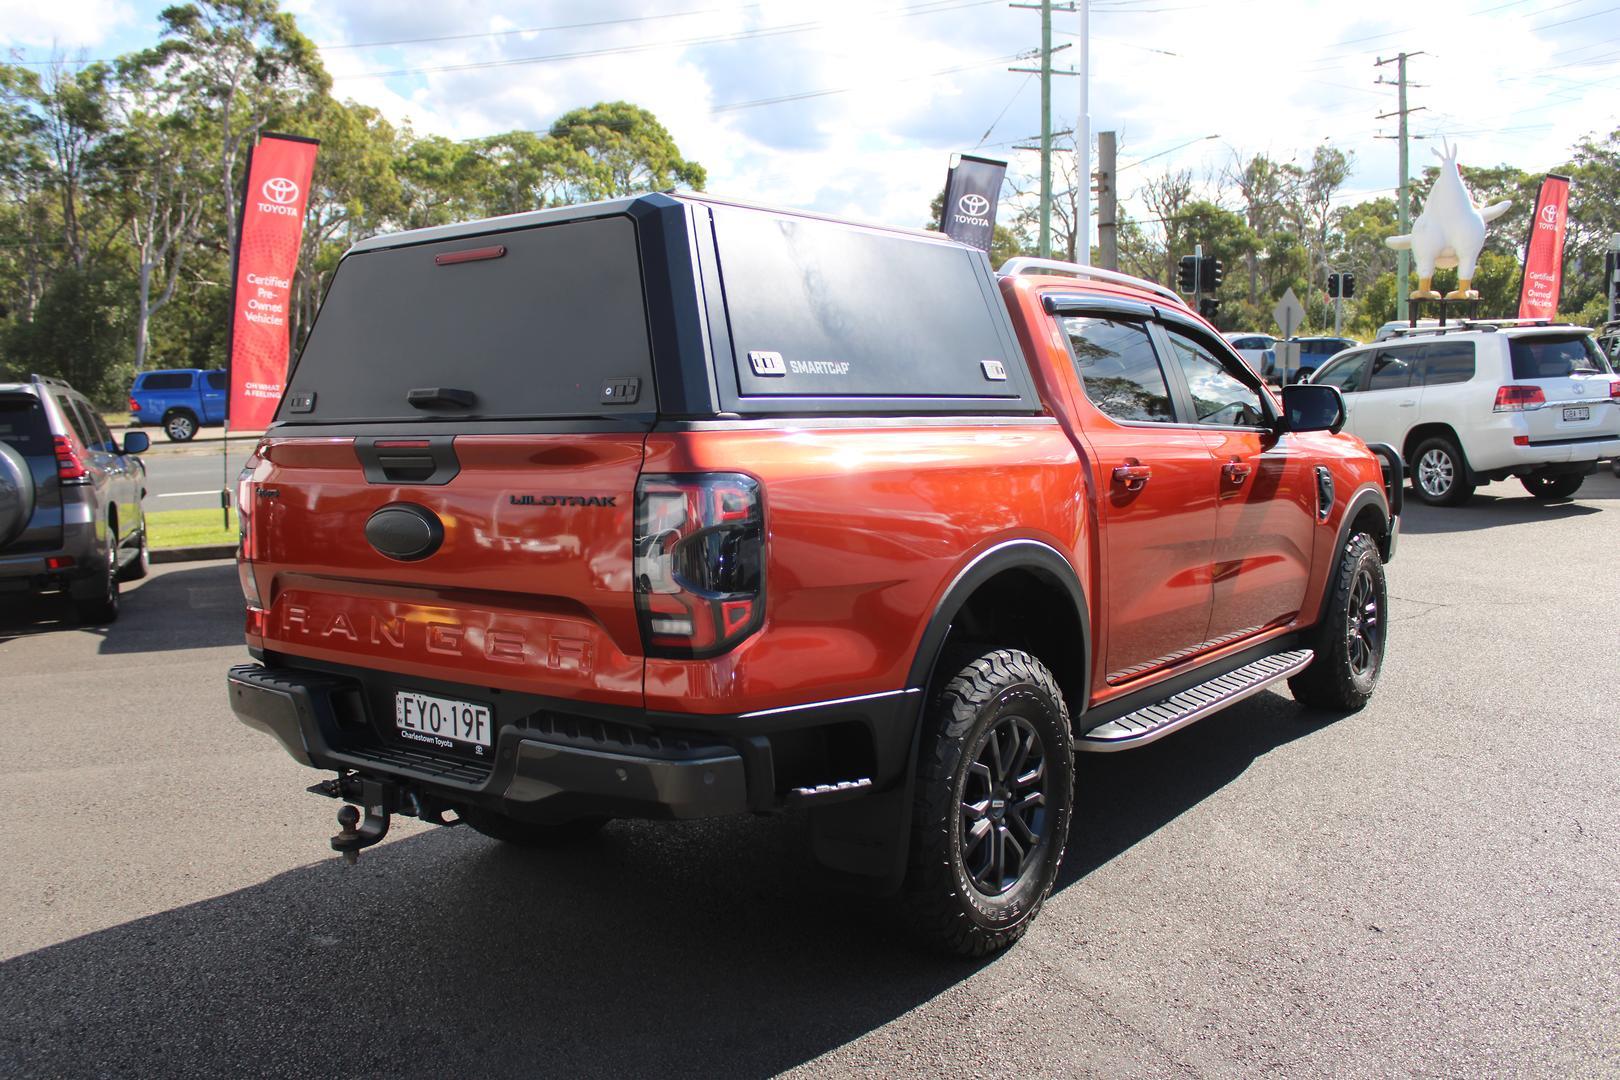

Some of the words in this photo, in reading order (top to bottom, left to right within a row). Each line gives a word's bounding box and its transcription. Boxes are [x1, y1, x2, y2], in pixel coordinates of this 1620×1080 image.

[257, 202, 298, 217] TOYOTA
[954, 214, 989, 227] TOYOTA
[247, 273, 289, 289] Certified
[257, 288, 278, 299] Pre-
[248, 300, 283, 313] Owned
[789, 360, 849, 375] SMARTCAP
[510, 495, 616, 507] WILDTRAK
[282, 605, 593, 674] RANGER
[401, 730, 434, 744] Charlestown
[434, 737, 453, 748] Toyota
